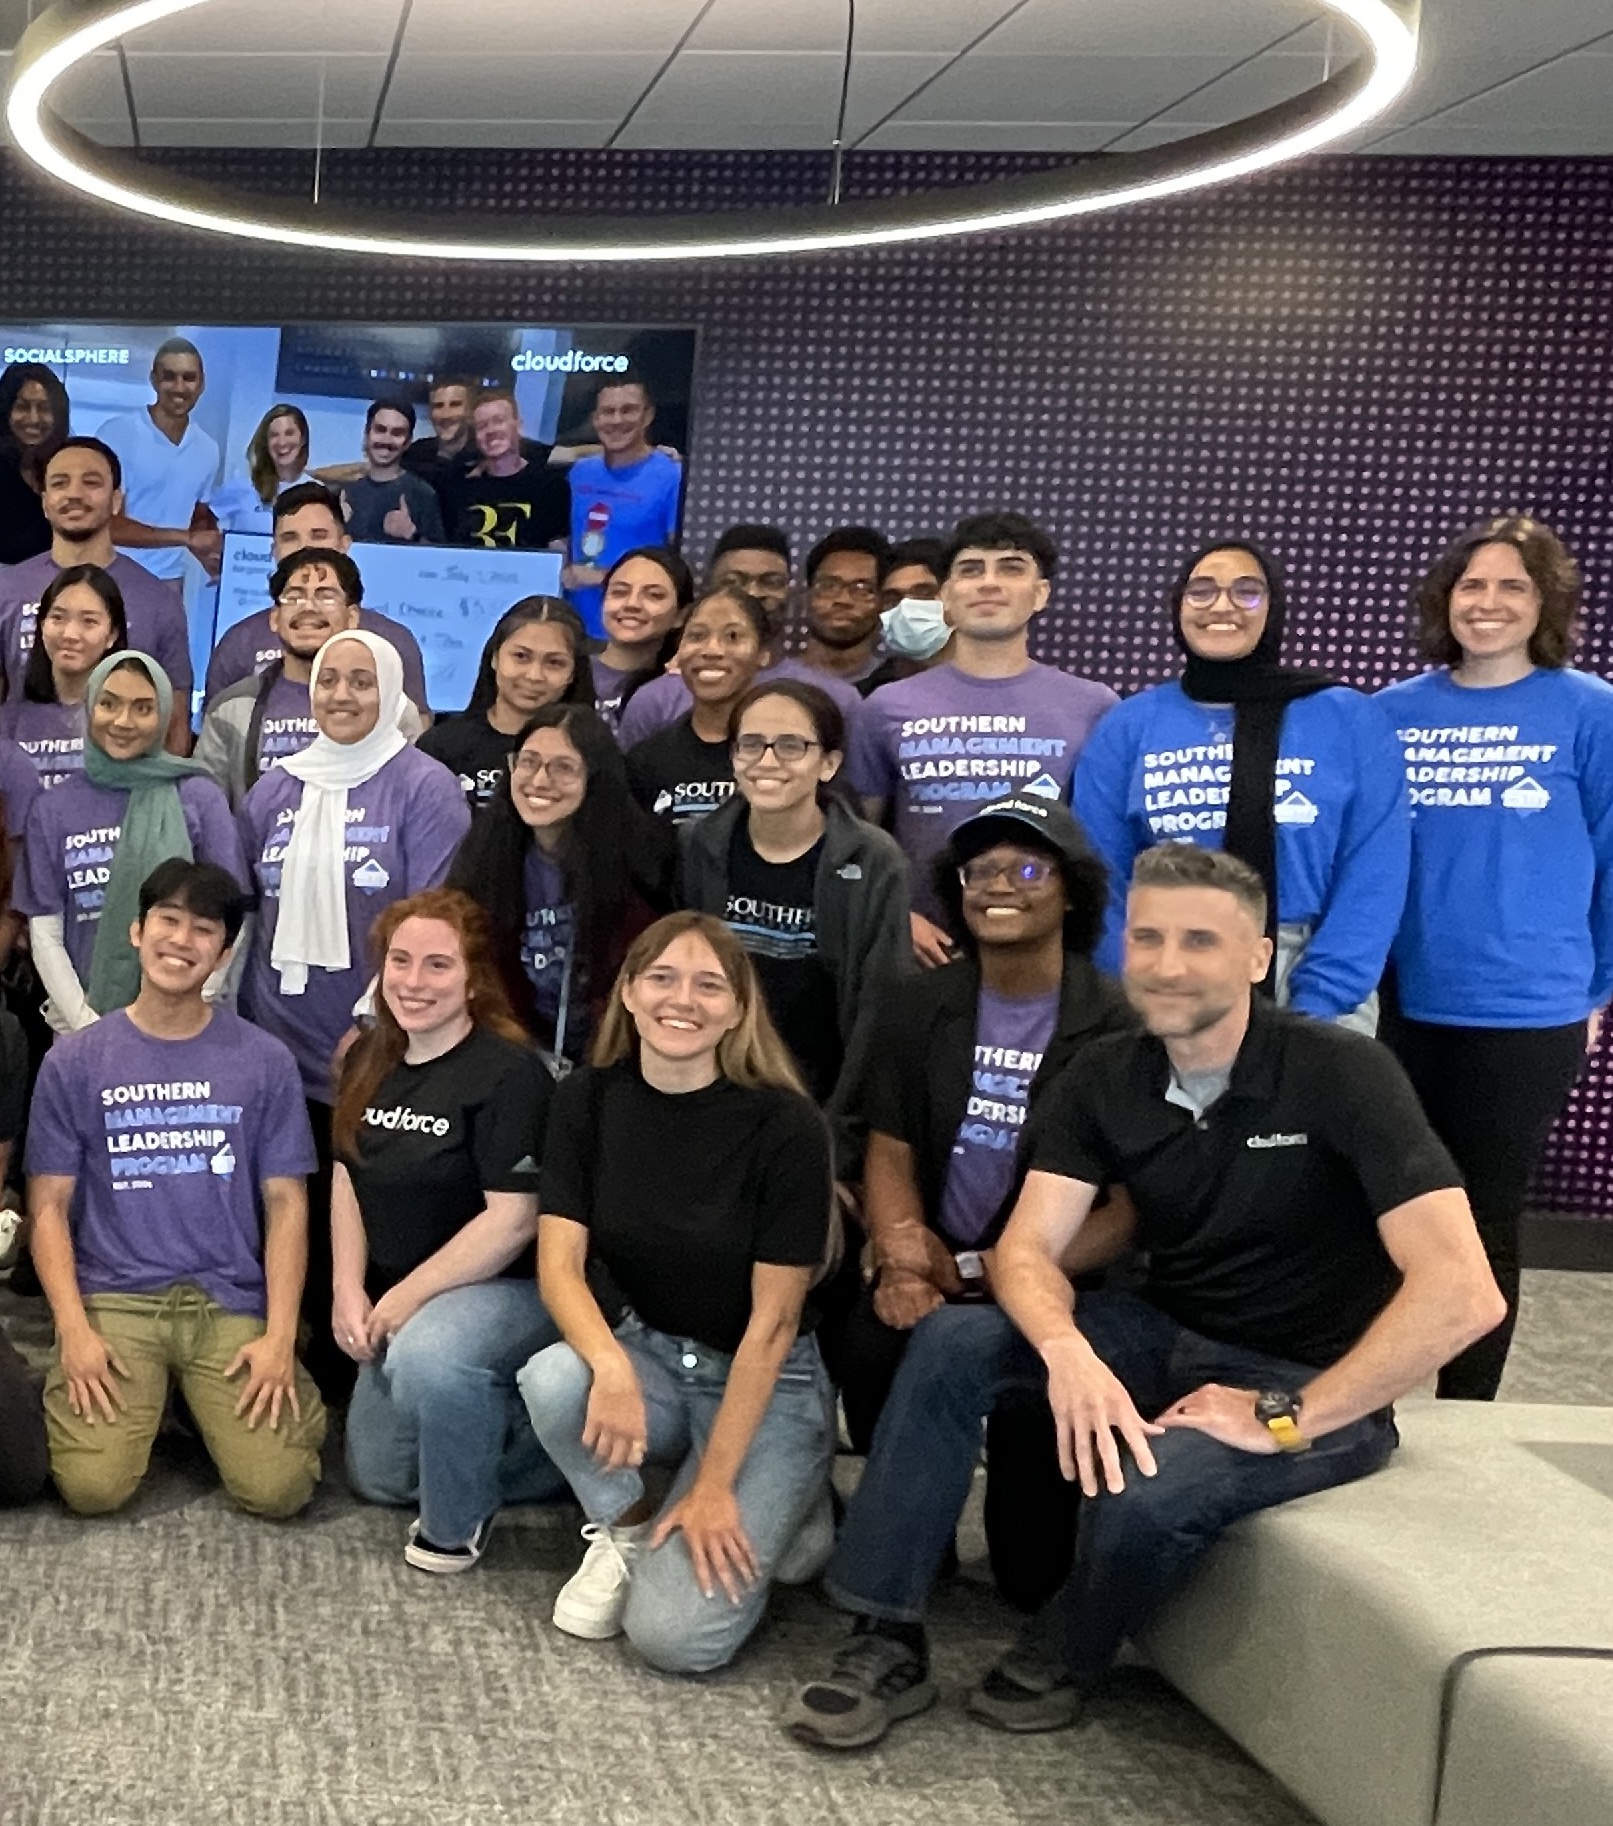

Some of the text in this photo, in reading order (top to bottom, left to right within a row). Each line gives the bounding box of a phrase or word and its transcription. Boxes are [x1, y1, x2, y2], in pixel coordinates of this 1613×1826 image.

[4, 348, 129, 364] SOCIALSPHERE
[511, 350, 629, 373] cloudforce
[901, 716, 1026, 737] SOUTHERN
[899, 737, 1067, 758] MANAGEMENT
[1404, 745, 1557, 763] ANAGEMENT
[901, 759, 1042, 780] LEADERSHIP
[1406, 765, 1525, 783] ADERSHIP
[1148, 811, 1228, 834] PROGR
[65, 826, 122, 850] SOUTH
[100, 1081, 211, 1106] SOUTHERN
[104, 1104, 244, 1129] MANAGEMENT
[106, 1129, 226, 1153] LEADERSHIP
[110, 1153, 208, 1177] PROGRAM
